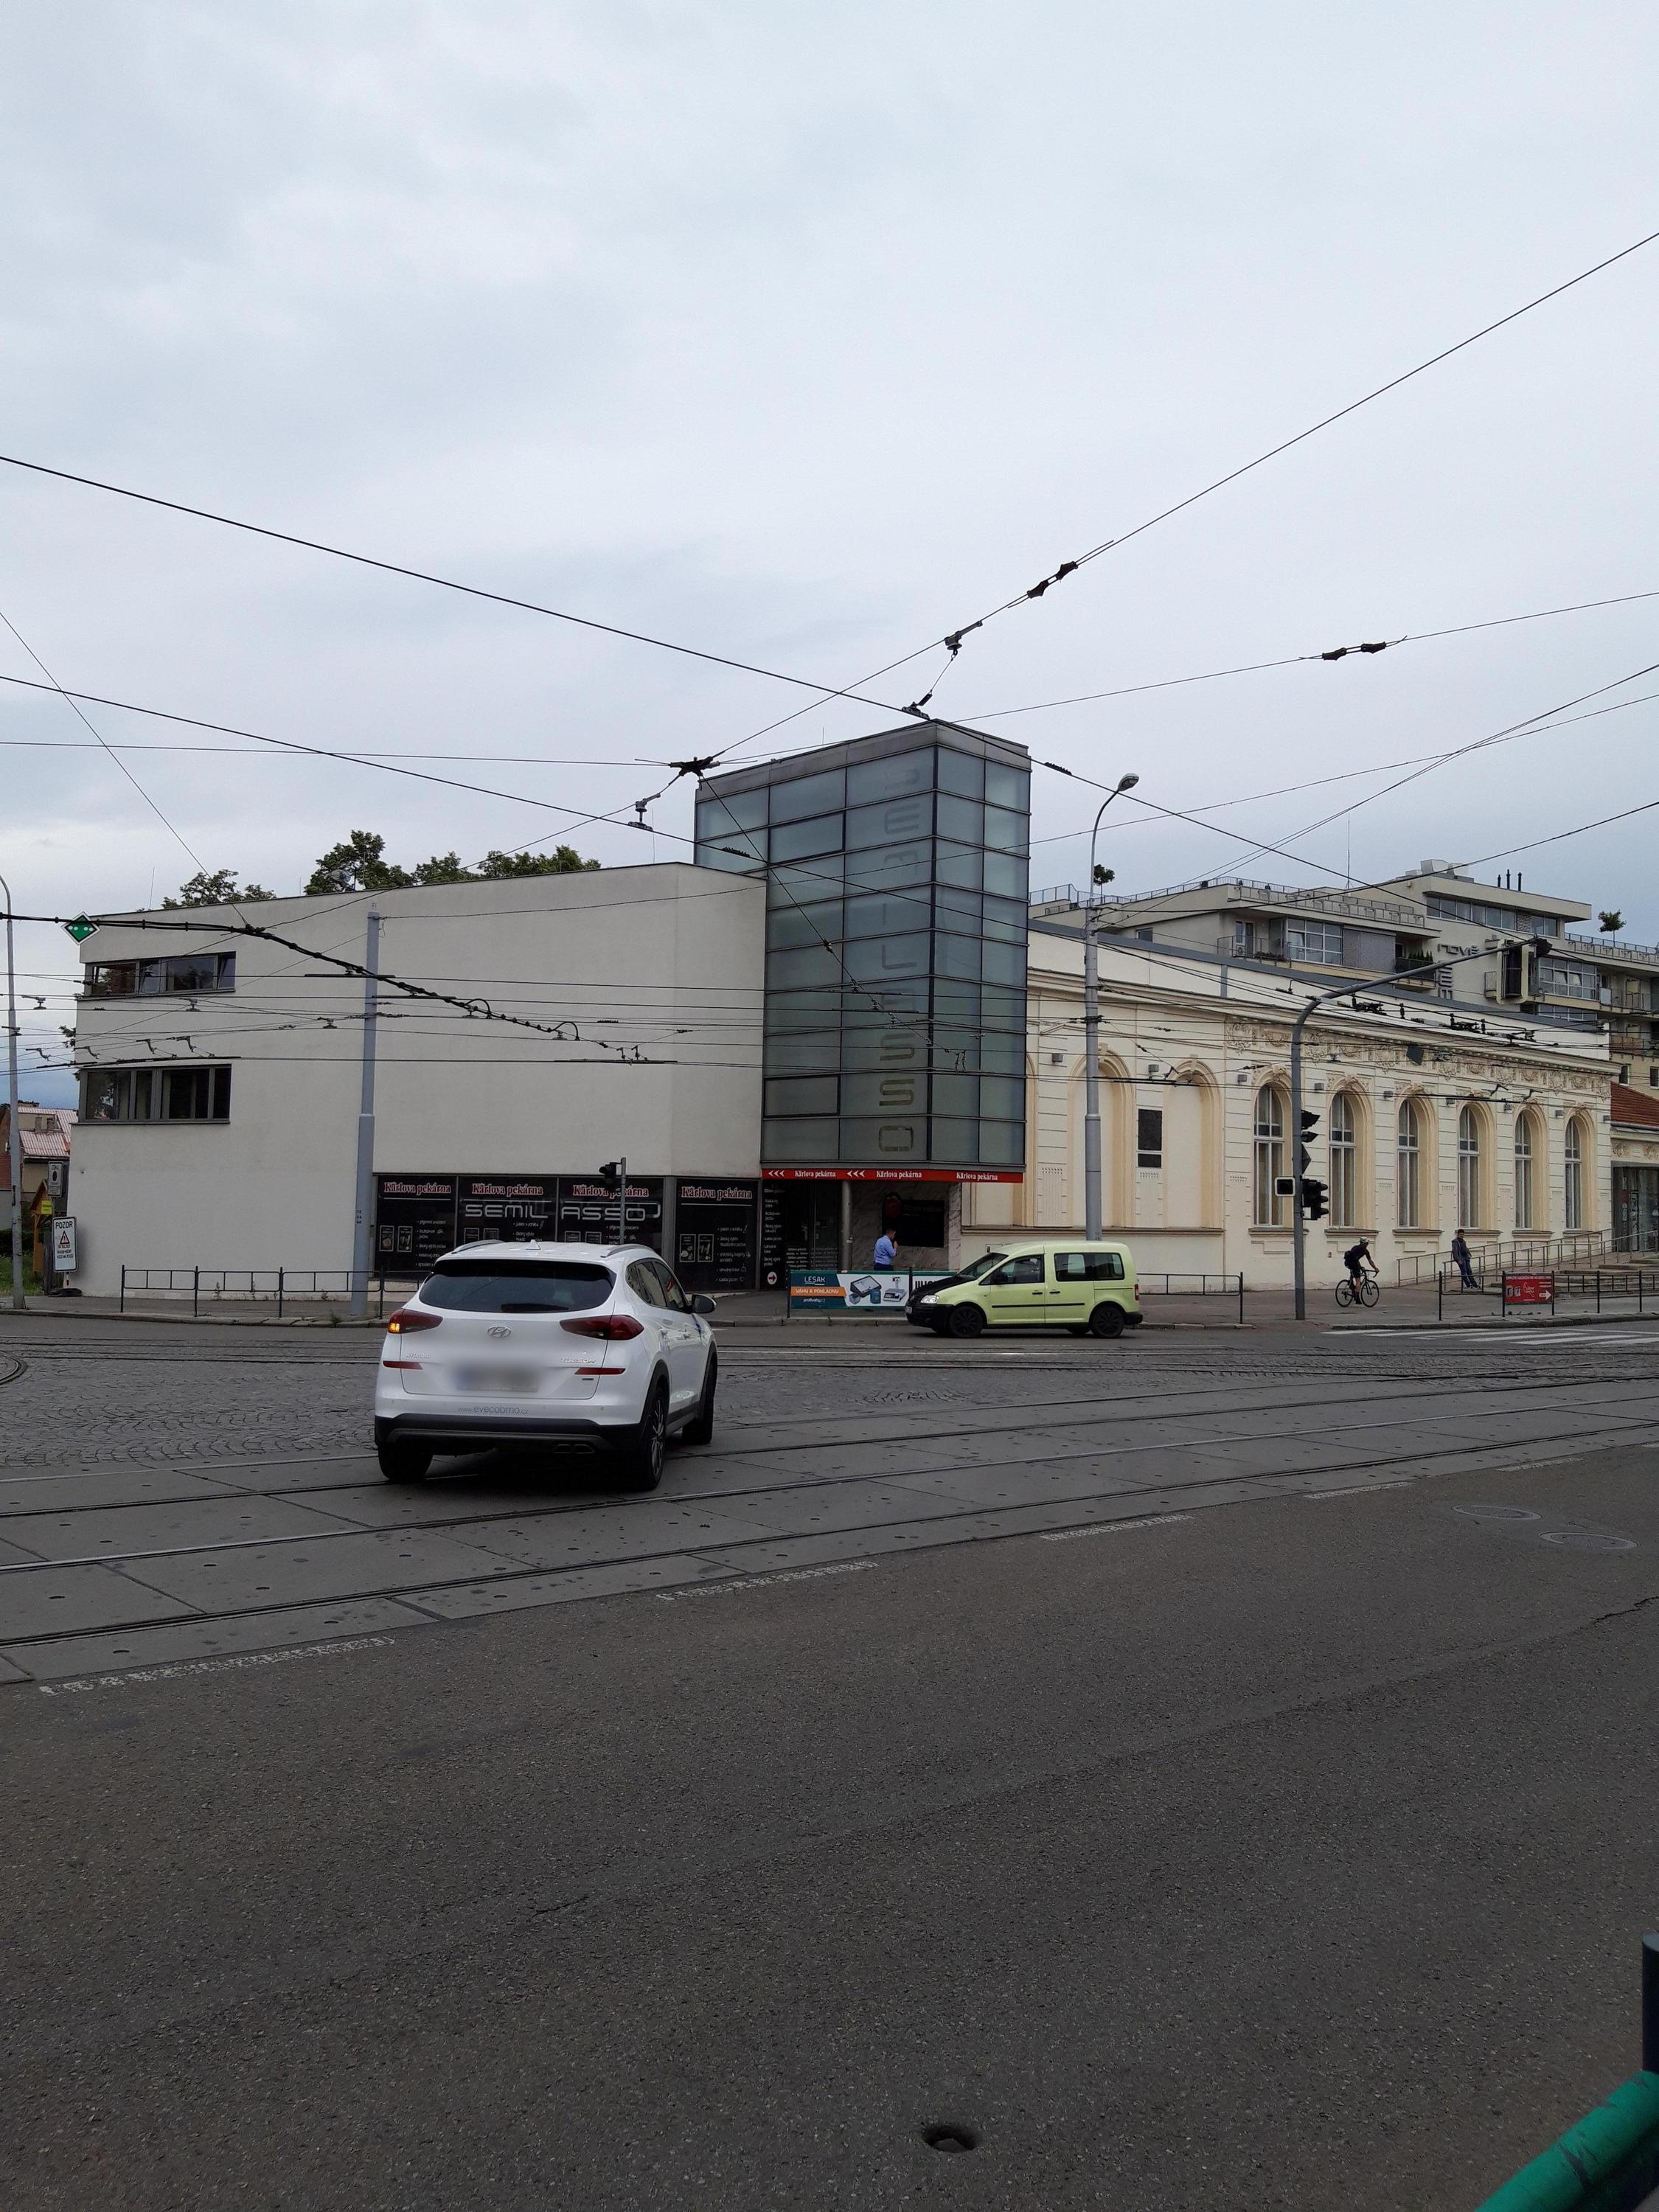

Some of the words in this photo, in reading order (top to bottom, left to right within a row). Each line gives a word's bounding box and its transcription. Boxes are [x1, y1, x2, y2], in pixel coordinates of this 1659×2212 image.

[815, 1170, 836, 1179] pekárna
[899, 1171, 922, 1179] pekárna
[977, 1173, 998, 1181] pekárna
[417, 1182, 451, 1195] pekárna
[507, 1183, 543, 1197] pekárna
[717, 1187, 753, 1201] pekárna
[465, 1204, 549, 1218] SEMIL
[55, 1221, 73, 1229] POZOR
